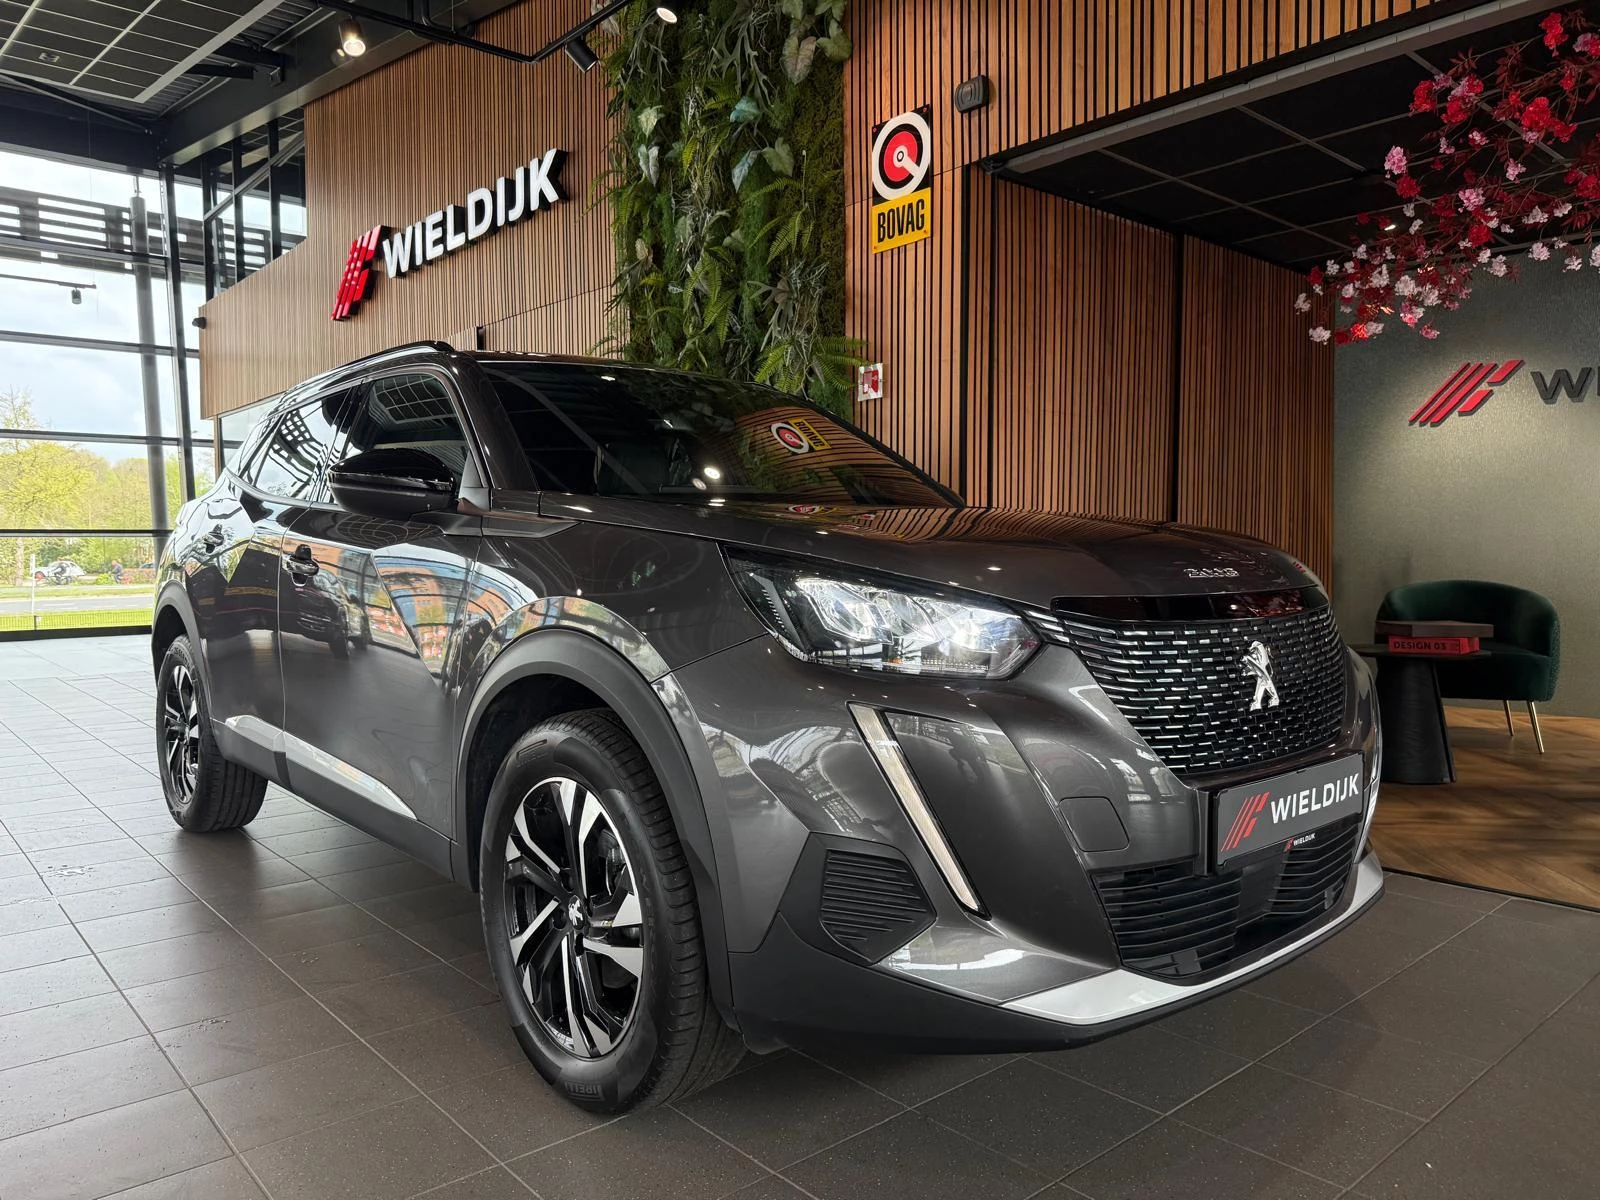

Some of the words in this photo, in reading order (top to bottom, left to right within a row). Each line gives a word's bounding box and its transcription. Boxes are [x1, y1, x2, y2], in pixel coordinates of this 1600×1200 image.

[382, 148, 561, 279] WIELDIJK
[877, 198, 925, 243] BOVAG
[1530, 366, 1600, 404] W
[1393, 640, 1431, 650] DESIGN
[1271, 773, 1360, 824] WIELDIJK
